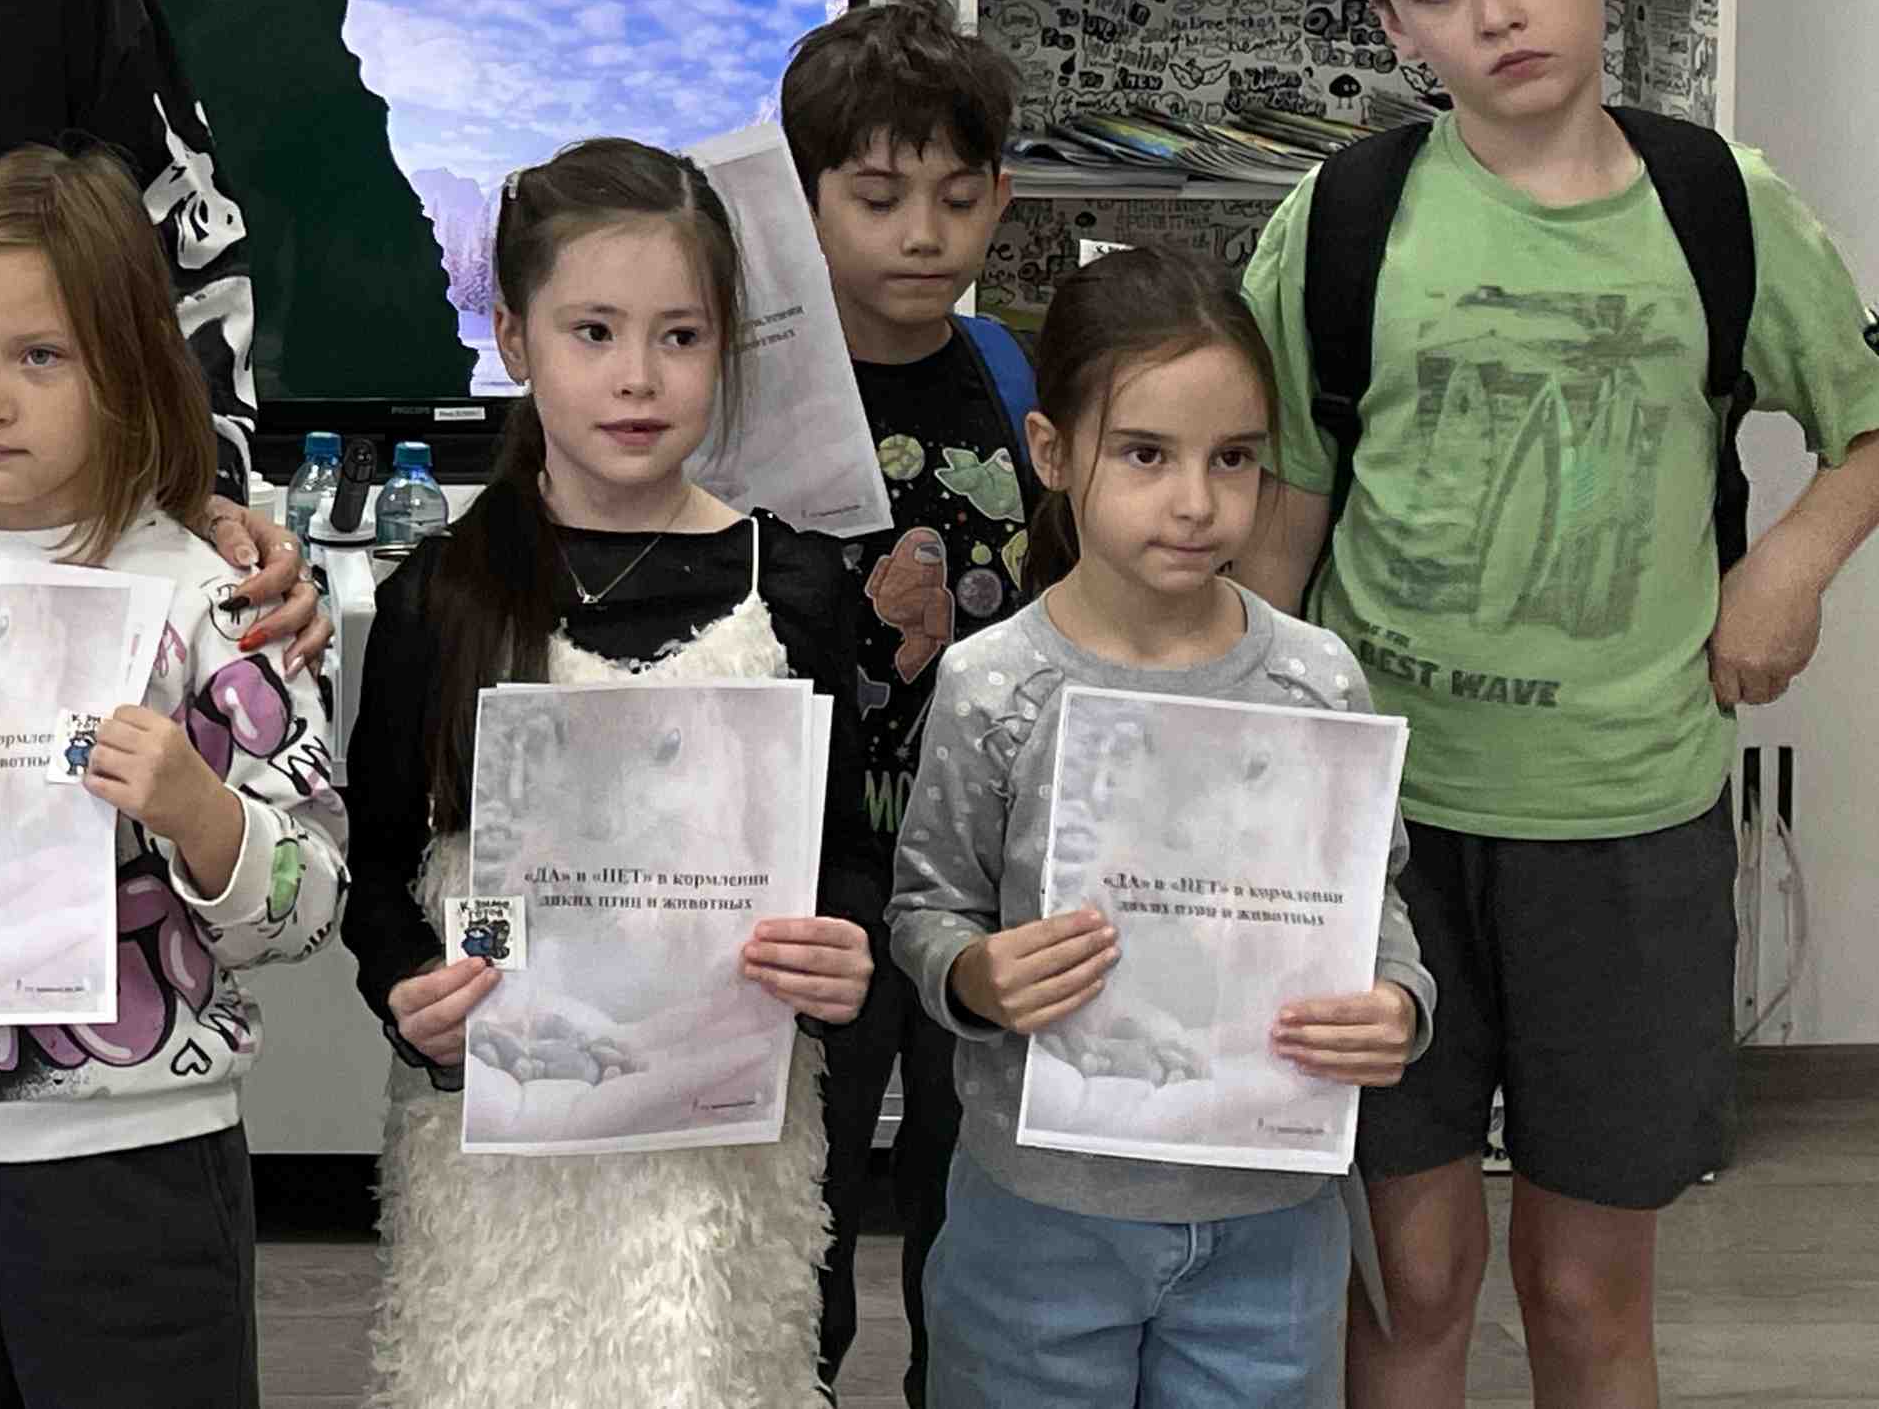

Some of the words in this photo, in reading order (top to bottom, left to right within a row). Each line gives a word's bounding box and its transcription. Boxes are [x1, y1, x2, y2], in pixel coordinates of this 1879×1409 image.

[1359, 637, 1441, 689] BEST
[1451, 668, 1562, 709] WAVE
[592, 870, 653, 885] «НЕТ»
[672, 873, 770, 890] кормлении
[538, 896, 593, 909] диких
[662, 897, 754, 911] животных
